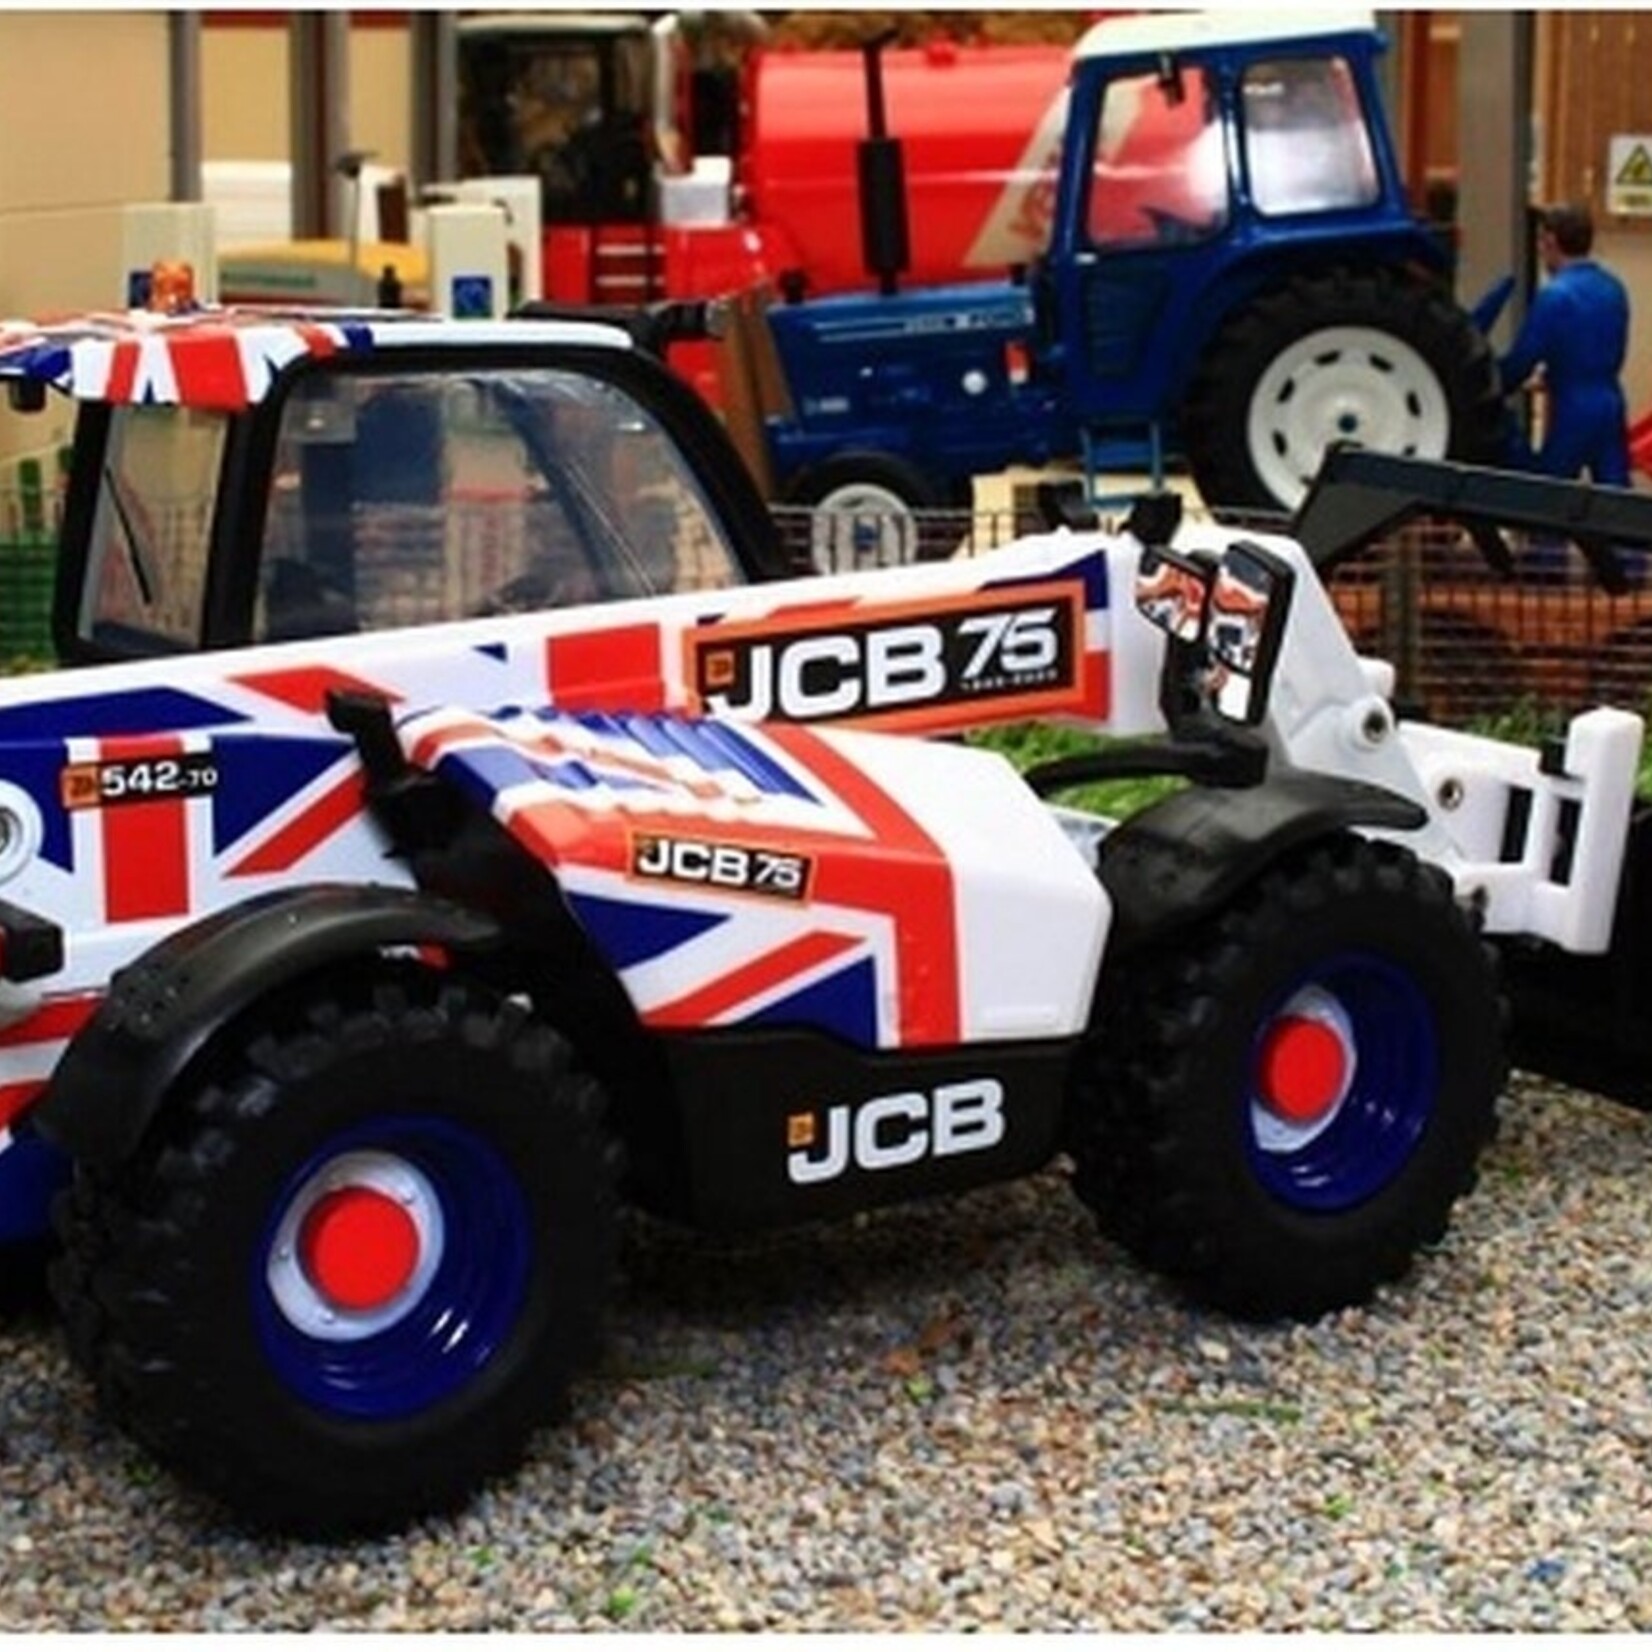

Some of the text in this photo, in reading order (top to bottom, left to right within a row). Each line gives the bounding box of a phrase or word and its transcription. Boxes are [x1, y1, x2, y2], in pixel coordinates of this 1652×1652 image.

[705, 606, 1059, 720] JCB 75
[637, 838, 803, 888] JCB 75
[787, 1077, 1005, 1184] JCB
